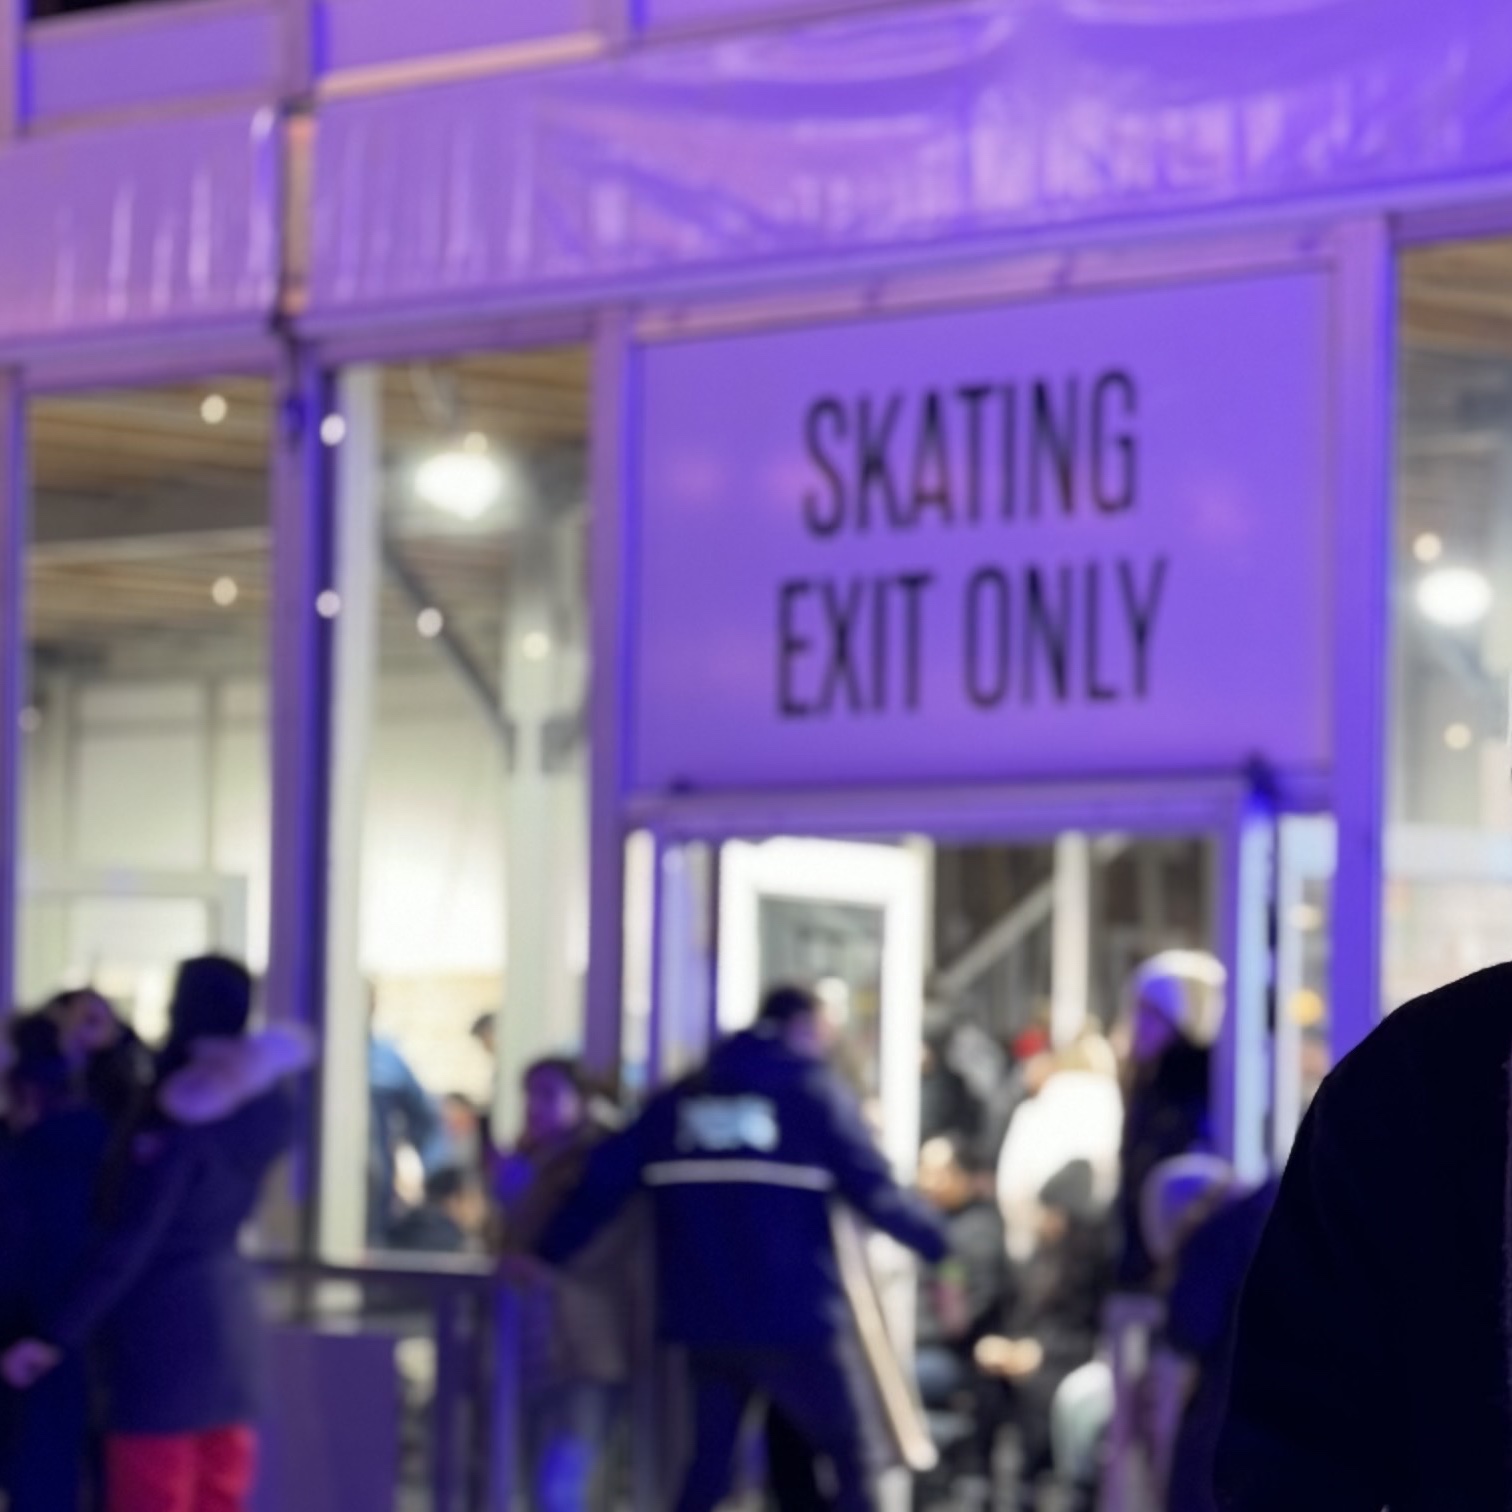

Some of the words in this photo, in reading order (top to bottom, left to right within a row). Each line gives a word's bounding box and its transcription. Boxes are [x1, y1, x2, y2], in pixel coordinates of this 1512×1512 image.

[803, 367, 1140, 538] SKATING
[776, 570, 936, 720] EXIT
[962, 552, 1171, 712] ONLY
